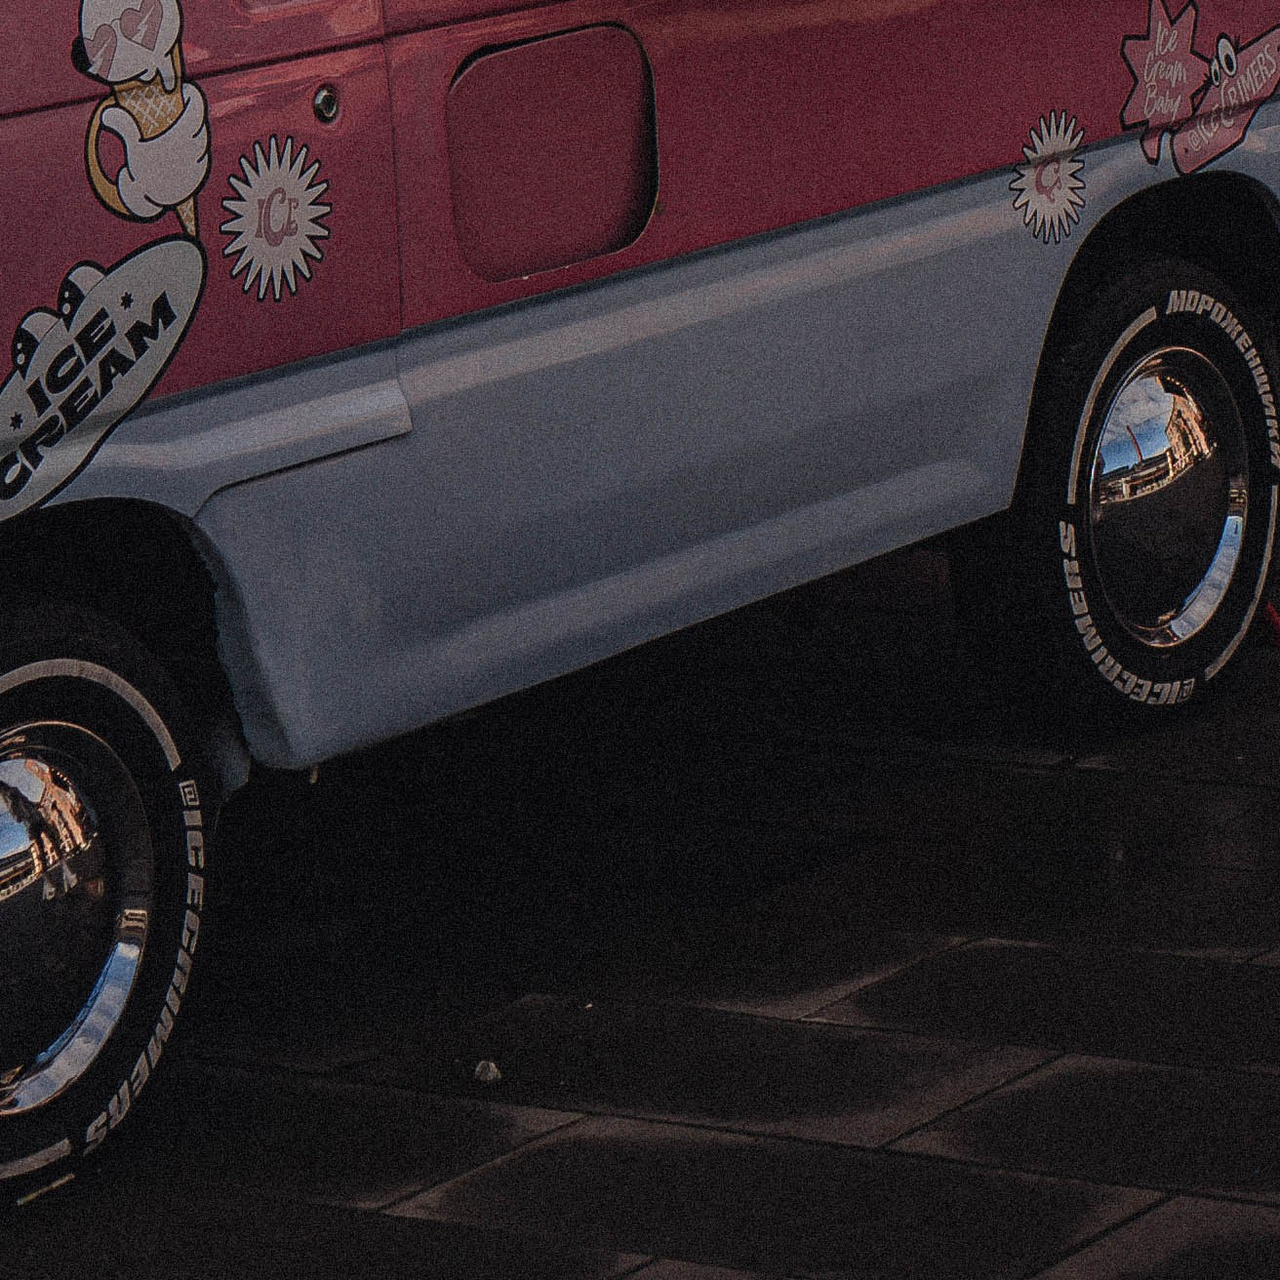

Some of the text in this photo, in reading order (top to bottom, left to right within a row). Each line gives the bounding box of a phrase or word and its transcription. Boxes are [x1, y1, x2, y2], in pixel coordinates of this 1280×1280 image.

[1152, 20, 1178, 57] Ice
[1143, 54, 1188, 86] Cream
[1142, 83, 1181, 119] Baby
[254, 186, 300, 248] ICE
[26, 307, 117, 419] ICE
[0, 289, 178, 500] CREAM
